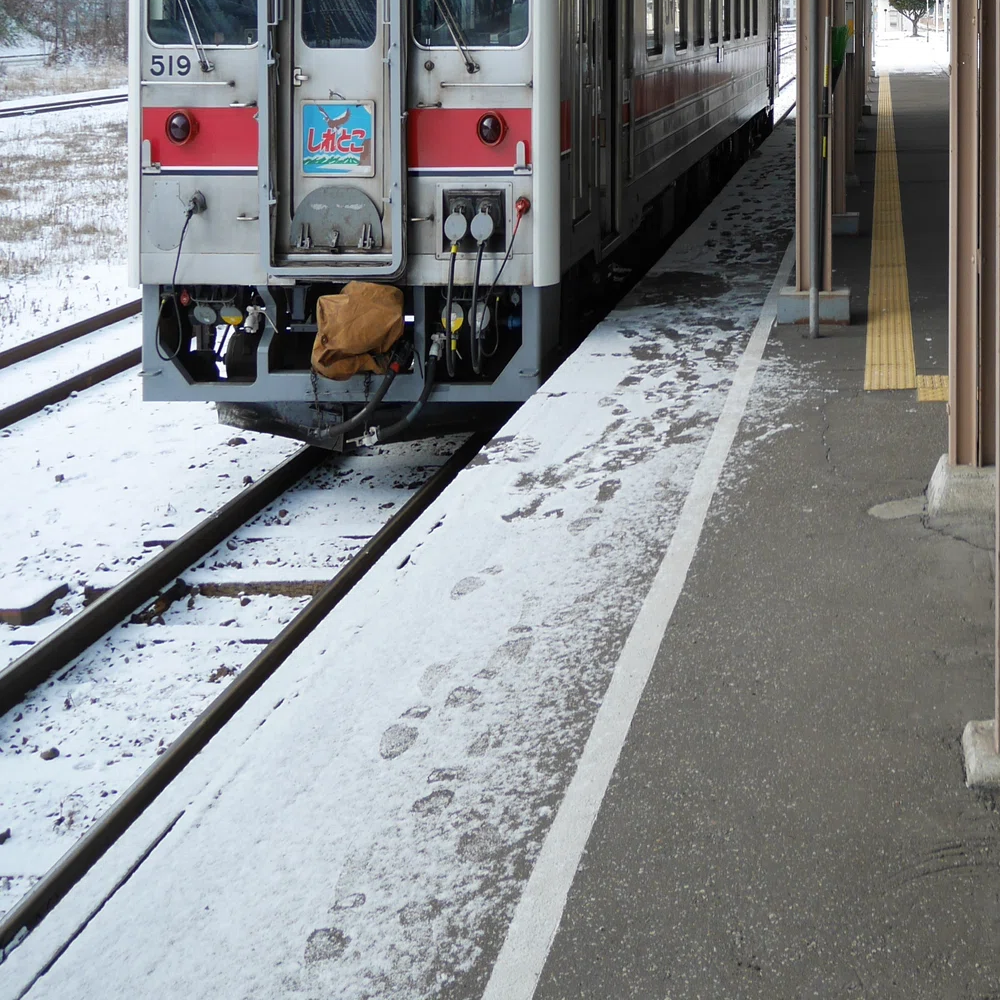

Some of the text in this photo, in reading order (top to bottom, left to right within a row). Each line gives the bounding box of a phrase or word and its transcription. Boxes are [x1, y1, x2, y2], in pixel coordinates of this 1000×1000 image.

[150, 55, 191, 76] 519
[307, 127, 367, 154] しれとこ
